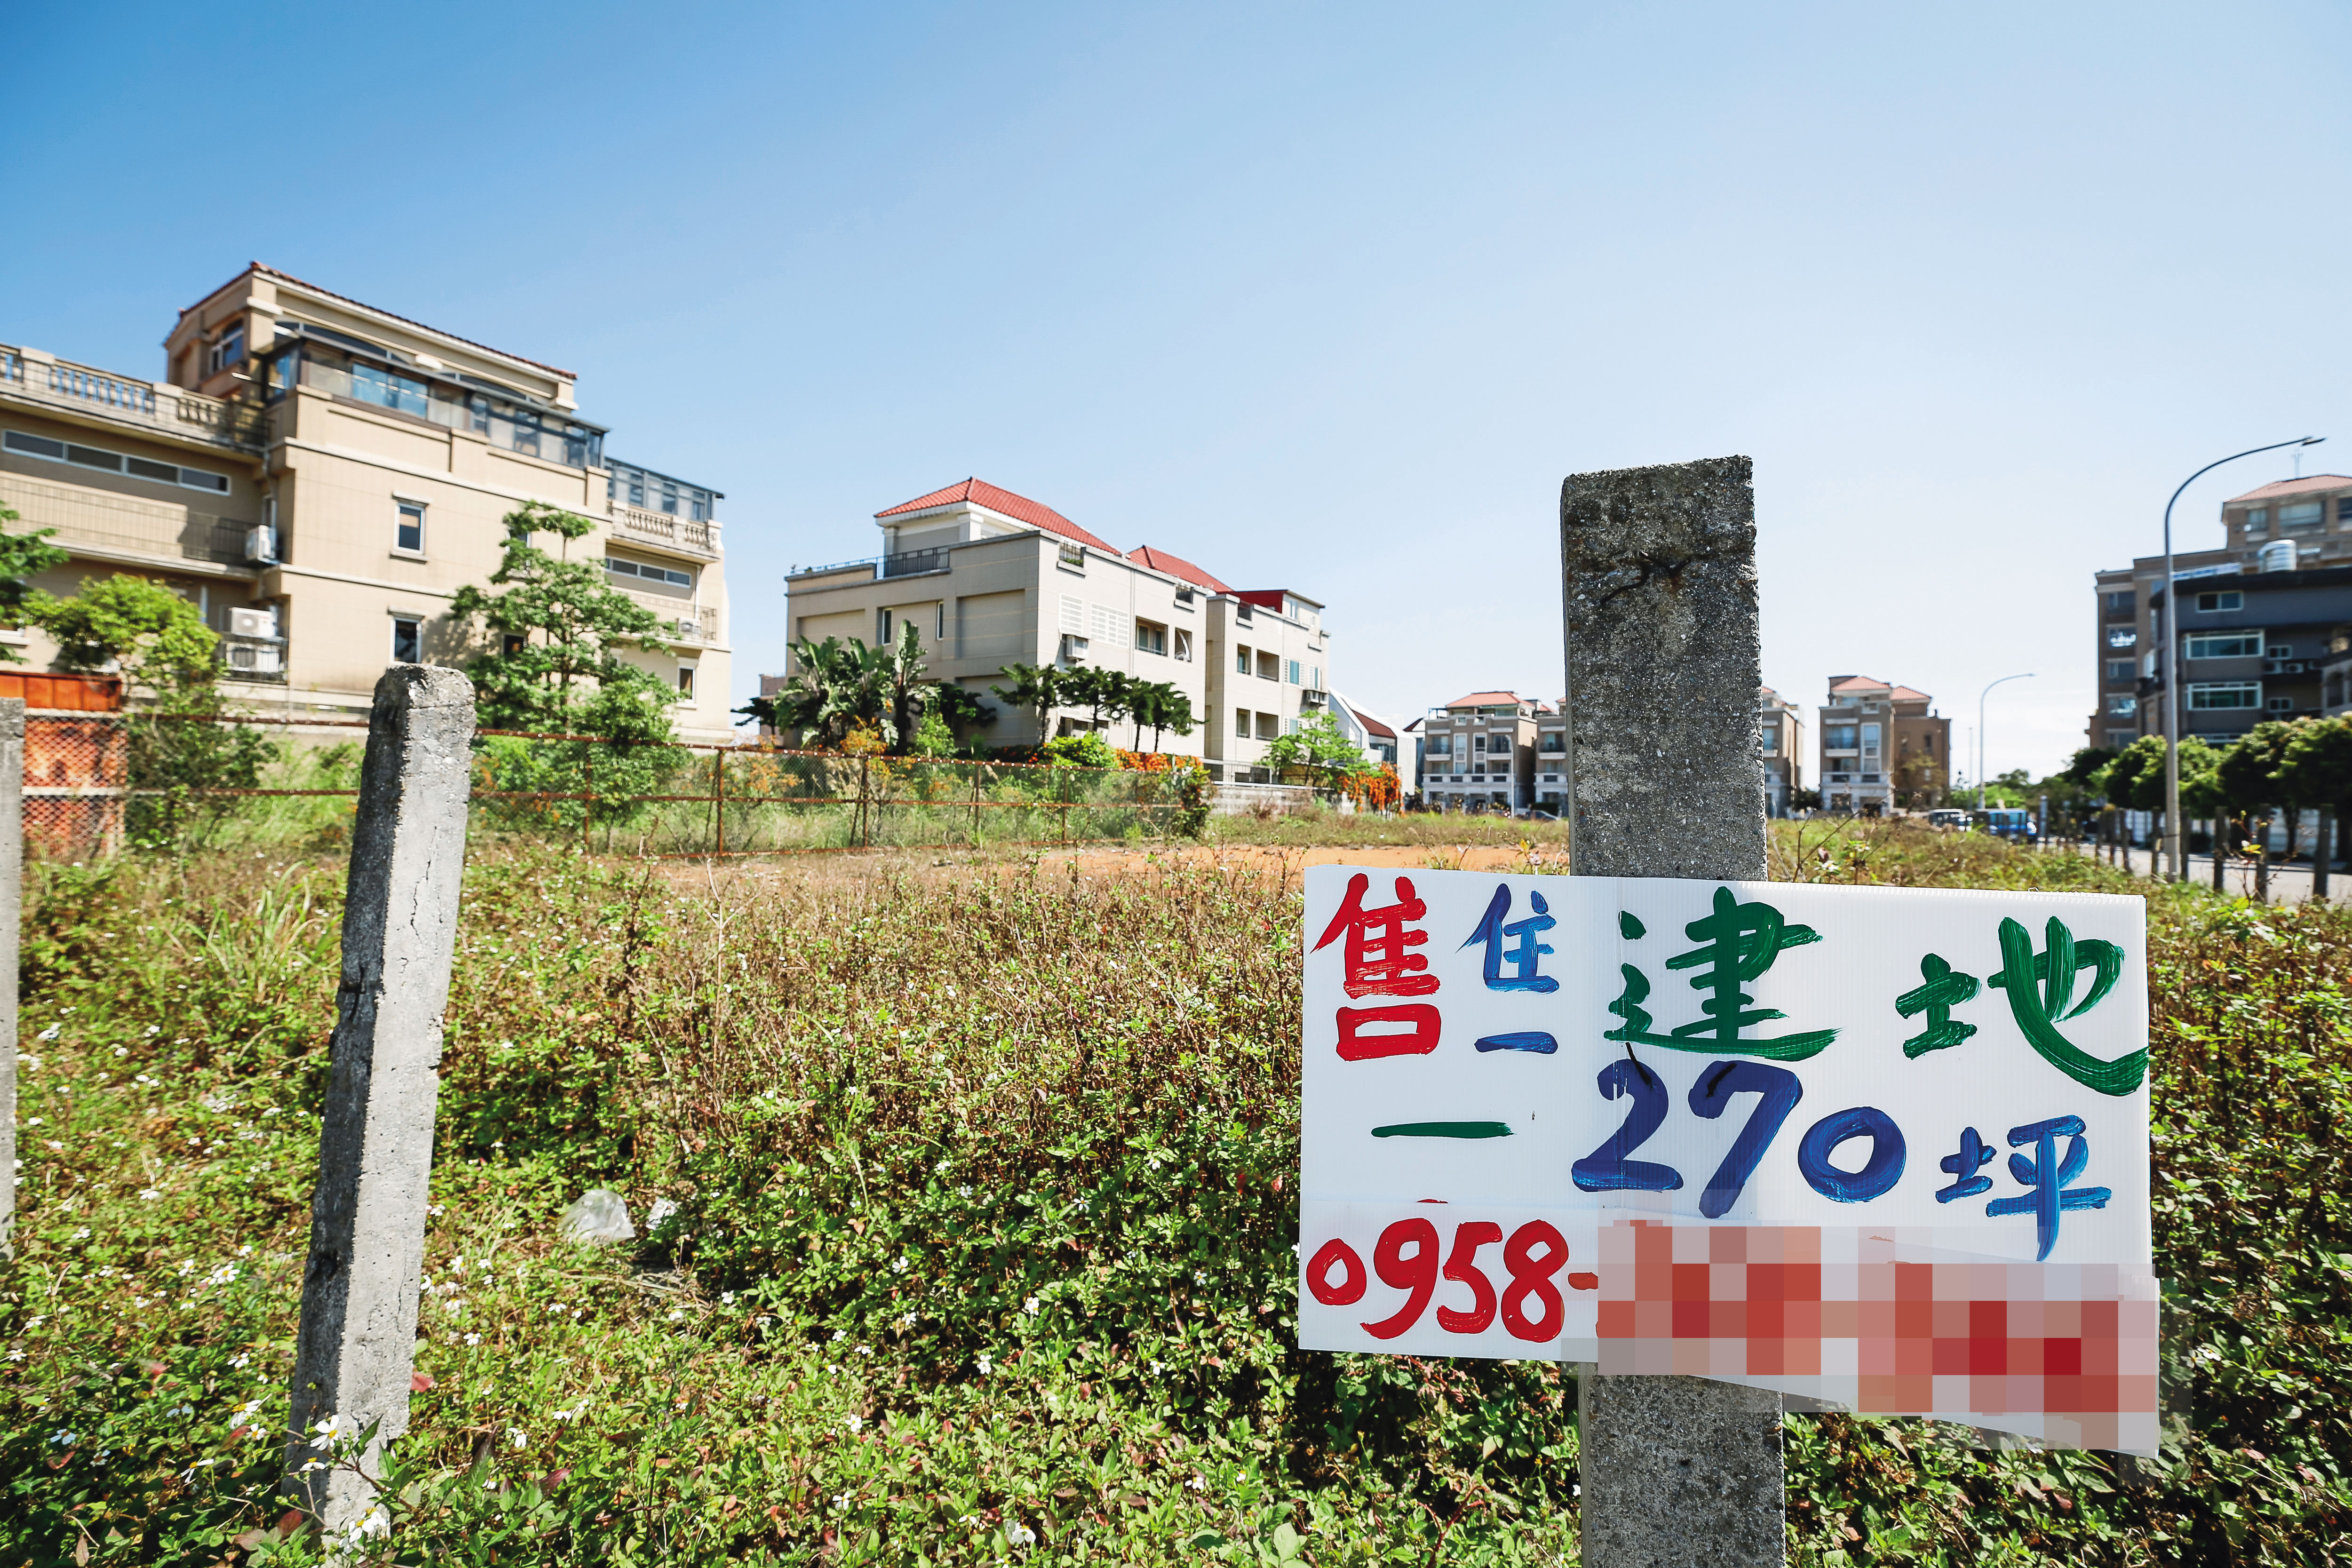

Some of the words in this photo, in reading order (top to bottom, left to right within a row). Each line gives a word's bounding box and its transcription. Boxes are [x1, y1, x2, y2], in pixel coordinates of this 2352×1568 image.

[1311, 873, 1441, 1061] 售
[1604, 886, 2149, 1096] 建地
[1572, 1059, 2112, 1262] 270坪
